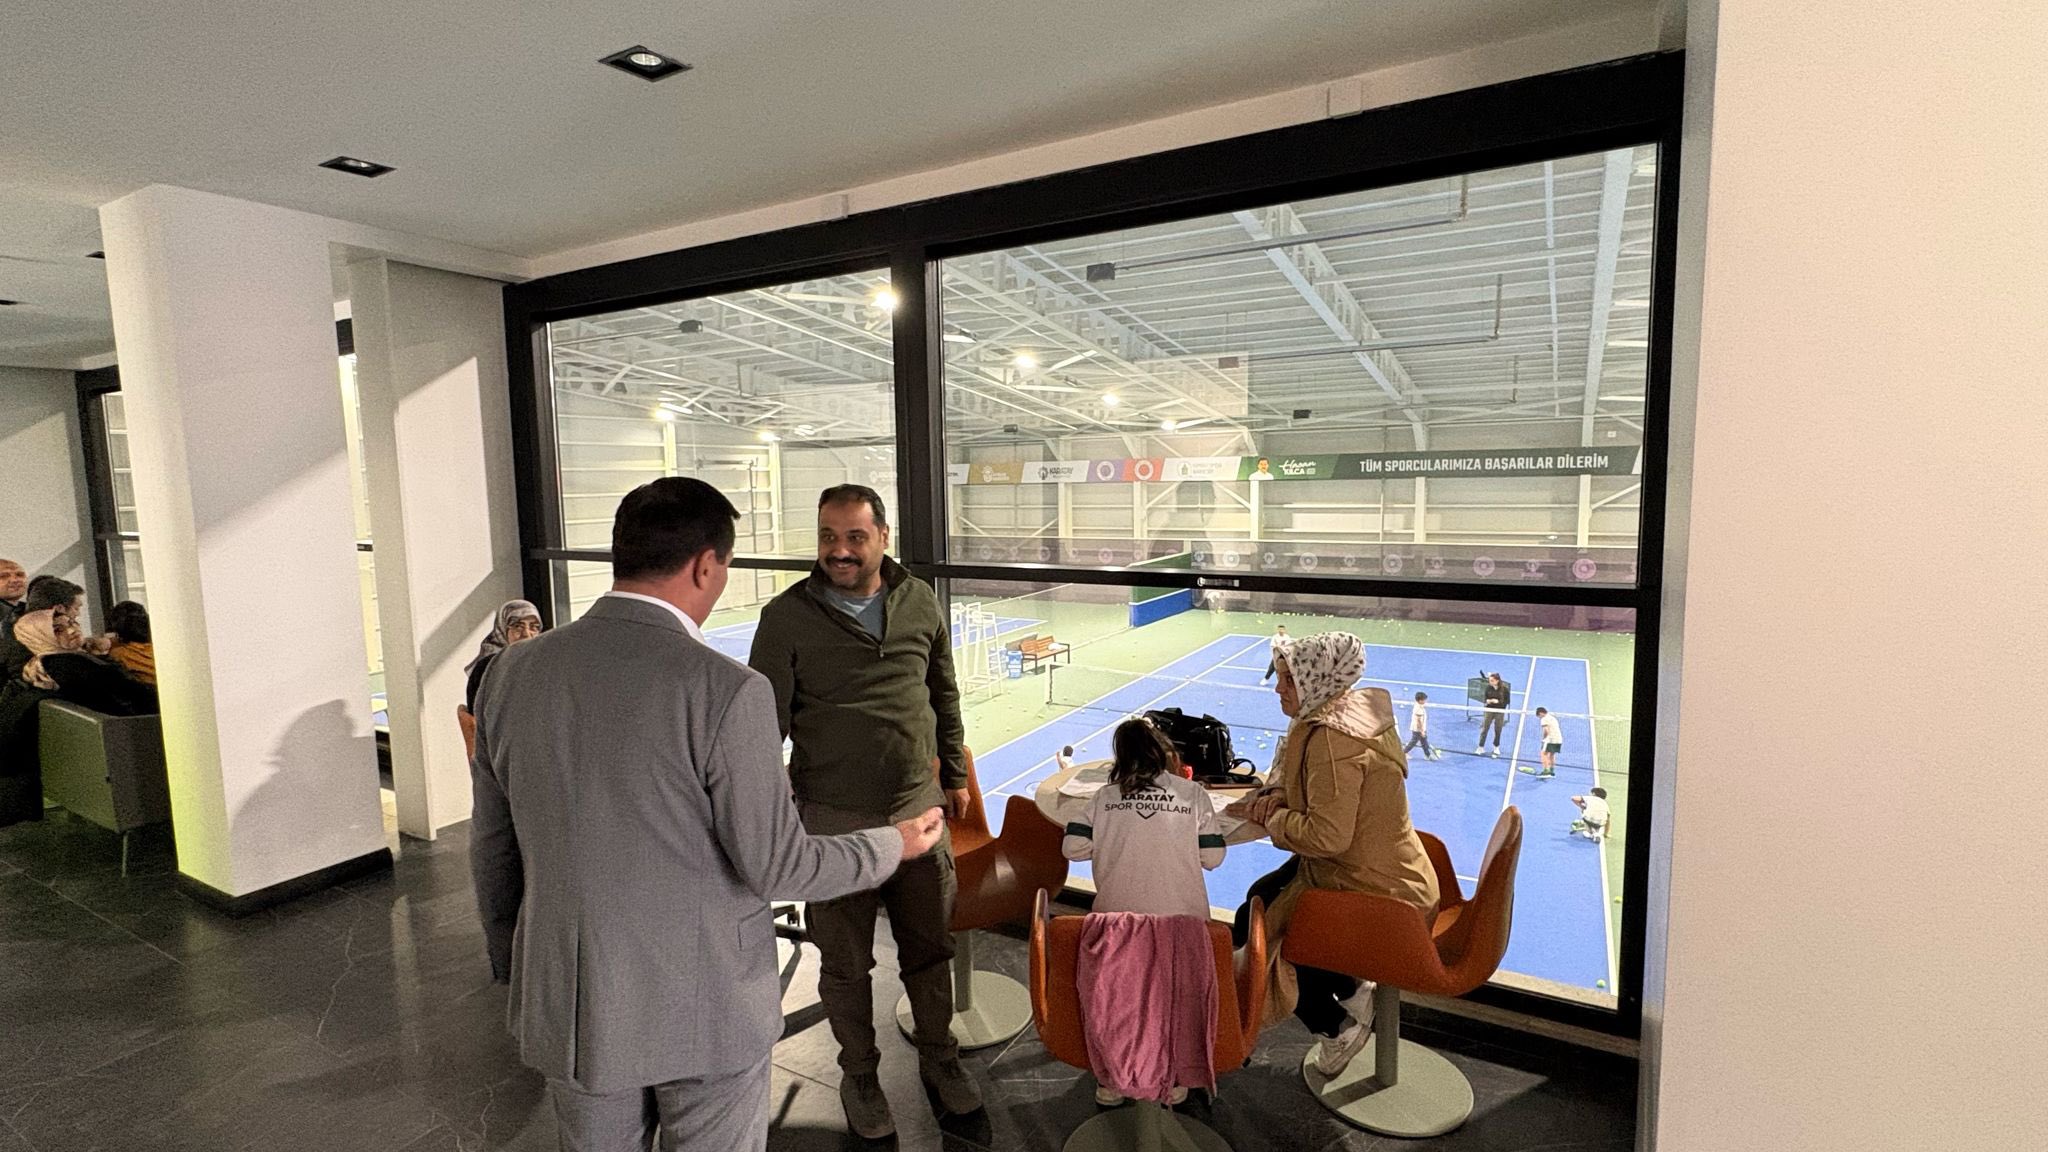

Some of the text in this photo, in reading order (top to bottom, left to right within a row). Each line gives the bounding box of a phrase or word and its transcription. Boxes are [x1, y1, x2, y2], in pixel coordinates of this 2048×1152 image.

[1360, 452, 1609, 472] TÜM SPORCULARIMIZA BAŞARILAR DİLERİM
[1121, 793, 1175, 803] KARATAY
[1104, 802, 1192, 815] SPOR OKULLARI
